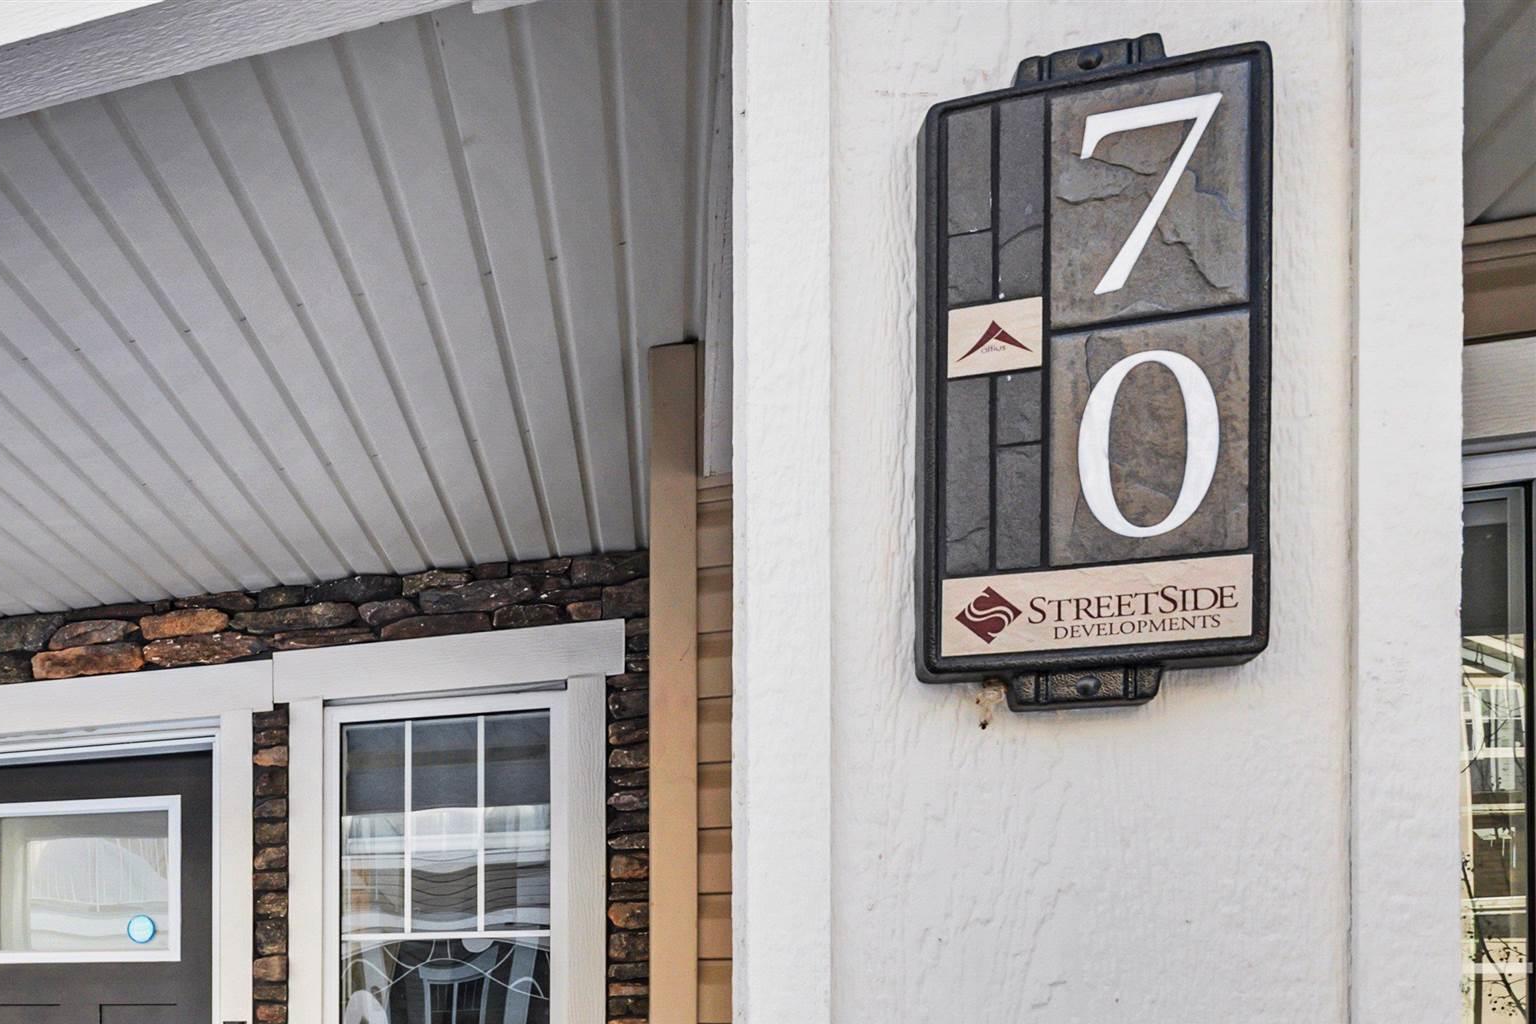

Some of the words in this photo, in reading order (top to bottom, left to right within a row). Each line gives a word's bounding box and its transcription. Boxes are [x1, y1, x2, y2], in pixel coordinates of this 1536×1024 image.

[1080, 91, 1223, 296] 7
[1077, 349, 1222, 539] 0
[1053, 613, 1221, 641] DEVELOPMENTS
